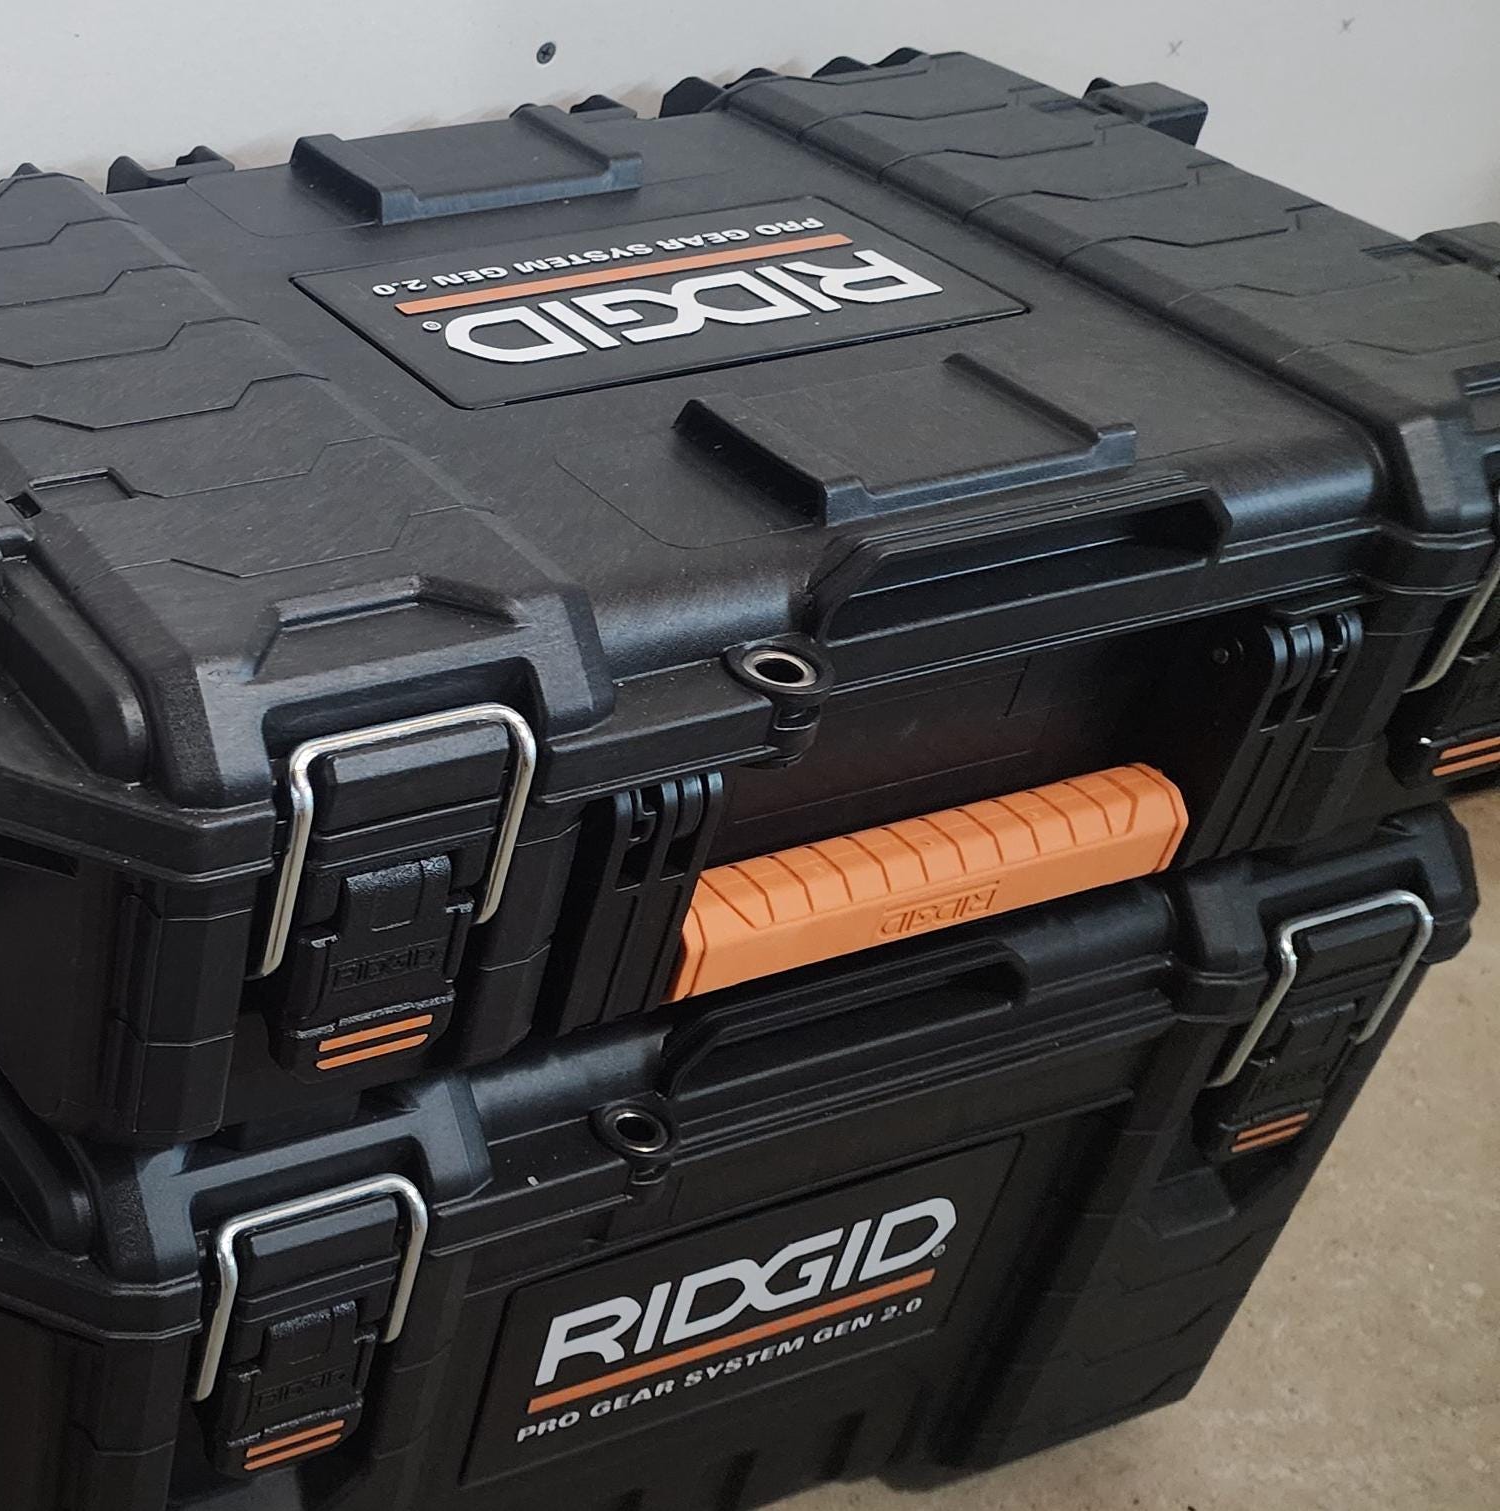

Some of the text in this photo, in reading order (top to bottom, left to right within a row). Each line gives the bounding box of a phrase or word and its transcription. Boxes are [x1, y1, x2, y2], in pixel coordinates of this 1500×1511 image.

[372, 216, 825, 296] PRO GEAR SYSTEM GEN 2.0
[444, 249, 944, 363] RIDGID
[534, 1197, 958, 1387] RIDGID
[516, 1296, 923, 1443] PRO GEAR SYSTEM GEN 2.0
